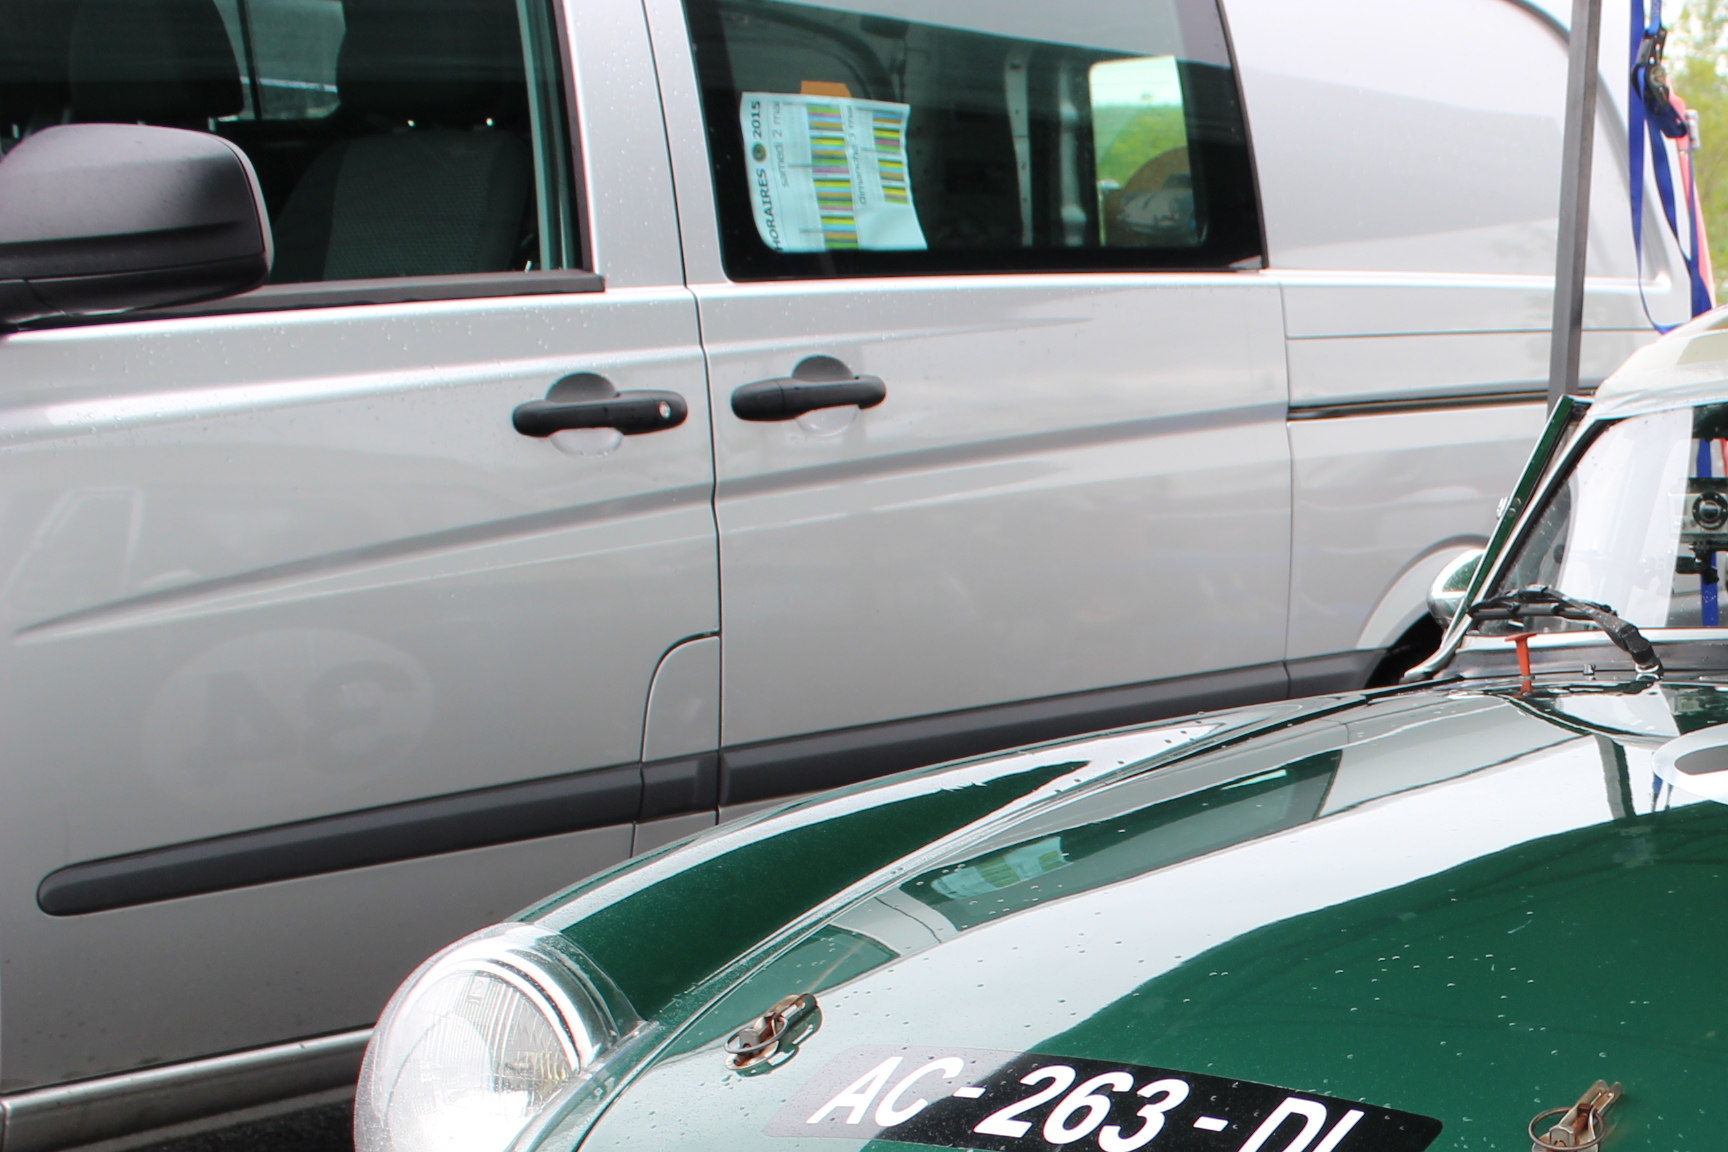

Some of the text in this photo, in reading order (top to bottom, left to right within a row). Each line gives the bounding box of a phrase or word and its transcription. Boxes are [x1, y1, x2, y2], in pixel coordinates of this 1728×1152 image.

[752, 100, 783, 251] HORAIRES 2015
[773, 143, 790, 188] samedi
